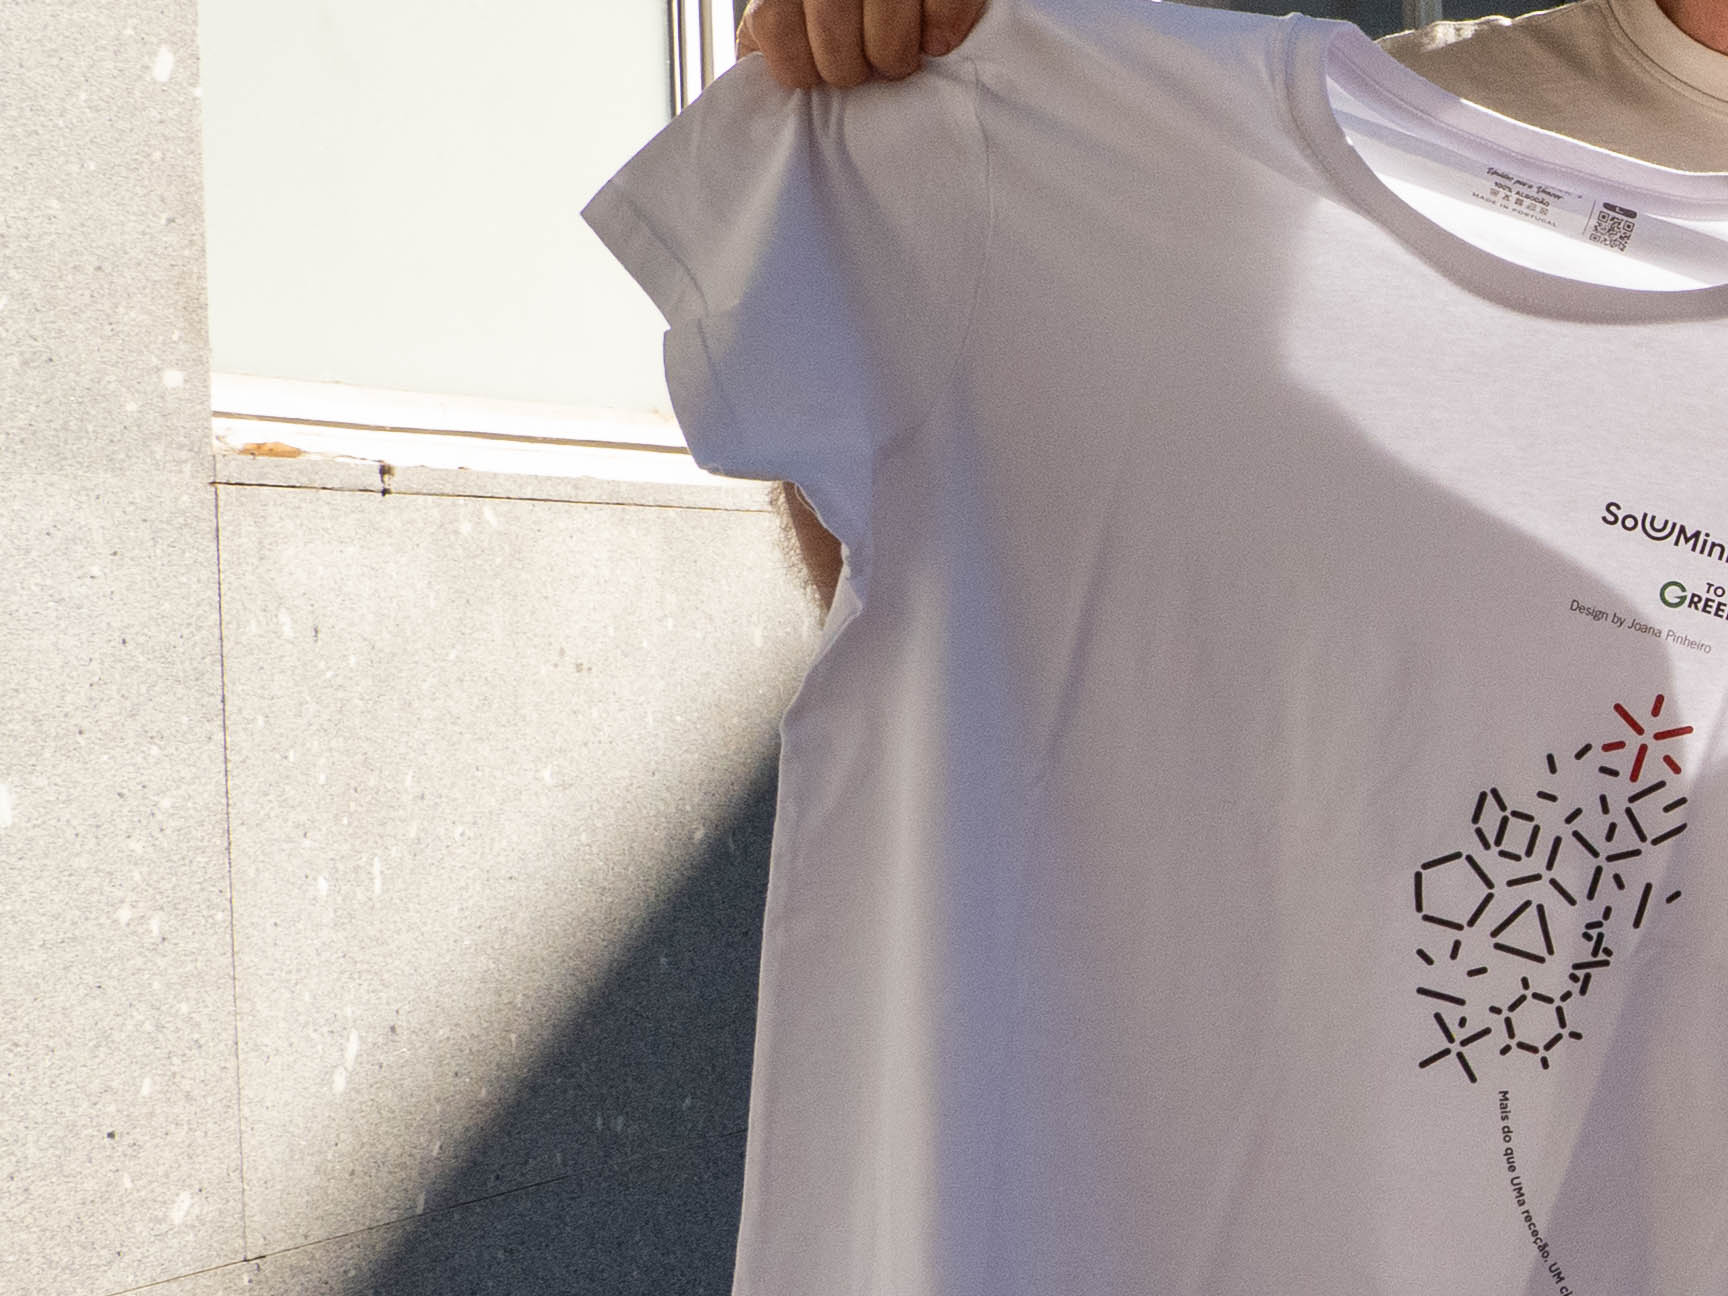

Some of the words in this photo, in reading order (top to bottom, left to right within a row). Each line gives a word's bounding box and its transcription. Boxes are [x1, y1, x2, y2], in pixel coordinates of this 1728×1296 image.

[1472, 192, 1496, 205] MADE
[1511, 207, 1557, 228] PORTUGAL
[1705, 582, 1726, 598] TO
[1570, 599, 1609, 622] Design
[1611, 612, 1627, 628] by
[1628, 618, 1662, 638] Joana
[1665, 629, 1712, 654] Pinheiro
[1499, 1090, 1511, 1123] Mais
[1502, 1125, 1512, 1143] do
[1504, 1147, 1517, 1173] que
[1510, 1176, 1526, 1207] UMa
[1520, 1208, 1550, 1263] receção,
[1548, 1262, 1565, 1286] UM
